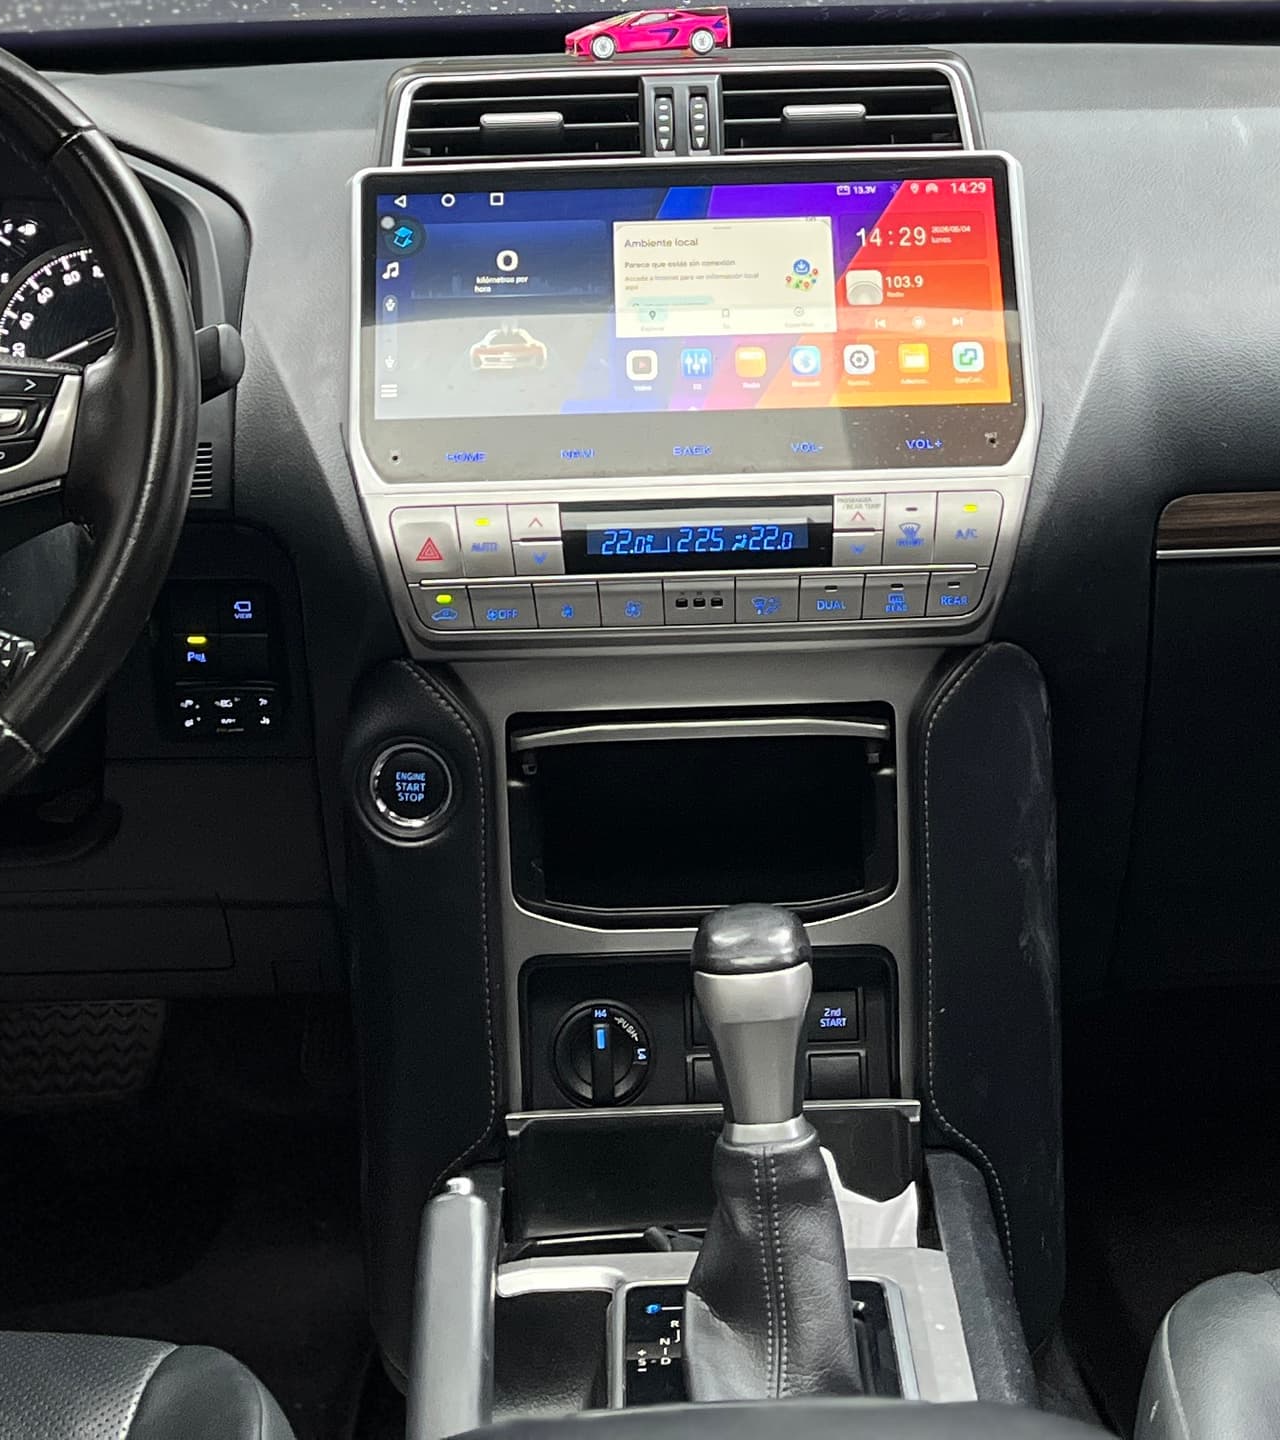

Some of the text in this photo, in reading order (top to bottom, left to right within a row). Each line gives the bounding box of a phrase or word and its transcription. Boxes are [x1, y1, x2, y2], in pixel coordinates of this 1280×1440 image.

[949, 182, 987, 194] 14:29
[624, 238, 698, 248] Ambiente local
[62, 272, 82, 287] 80
[885, 276, 924, 288] 103.9
[19, 311, 35, 331] 40
[905, 439, 943, 449] VOL+
[748, 526, 793, 550] 22.0
[954, 528, 978, 539] A/C
[601, 529, 645, 555] 22.0
[816, 600, 847, 610] DUAL
[940, 595, 969, 606] REAR
[395, 771, 426, 781] ENGINE
[395, 782, 426, 792] START
[398, 792, 425, 802] STOP
[824, 1008, 842, 1017] 2nd
[820, 1018, 847, 1028] START
[670, 1320, 680, 1328] R
[660, 1337, 670, 1345] N
[661, 1357, 671, 1365] D
